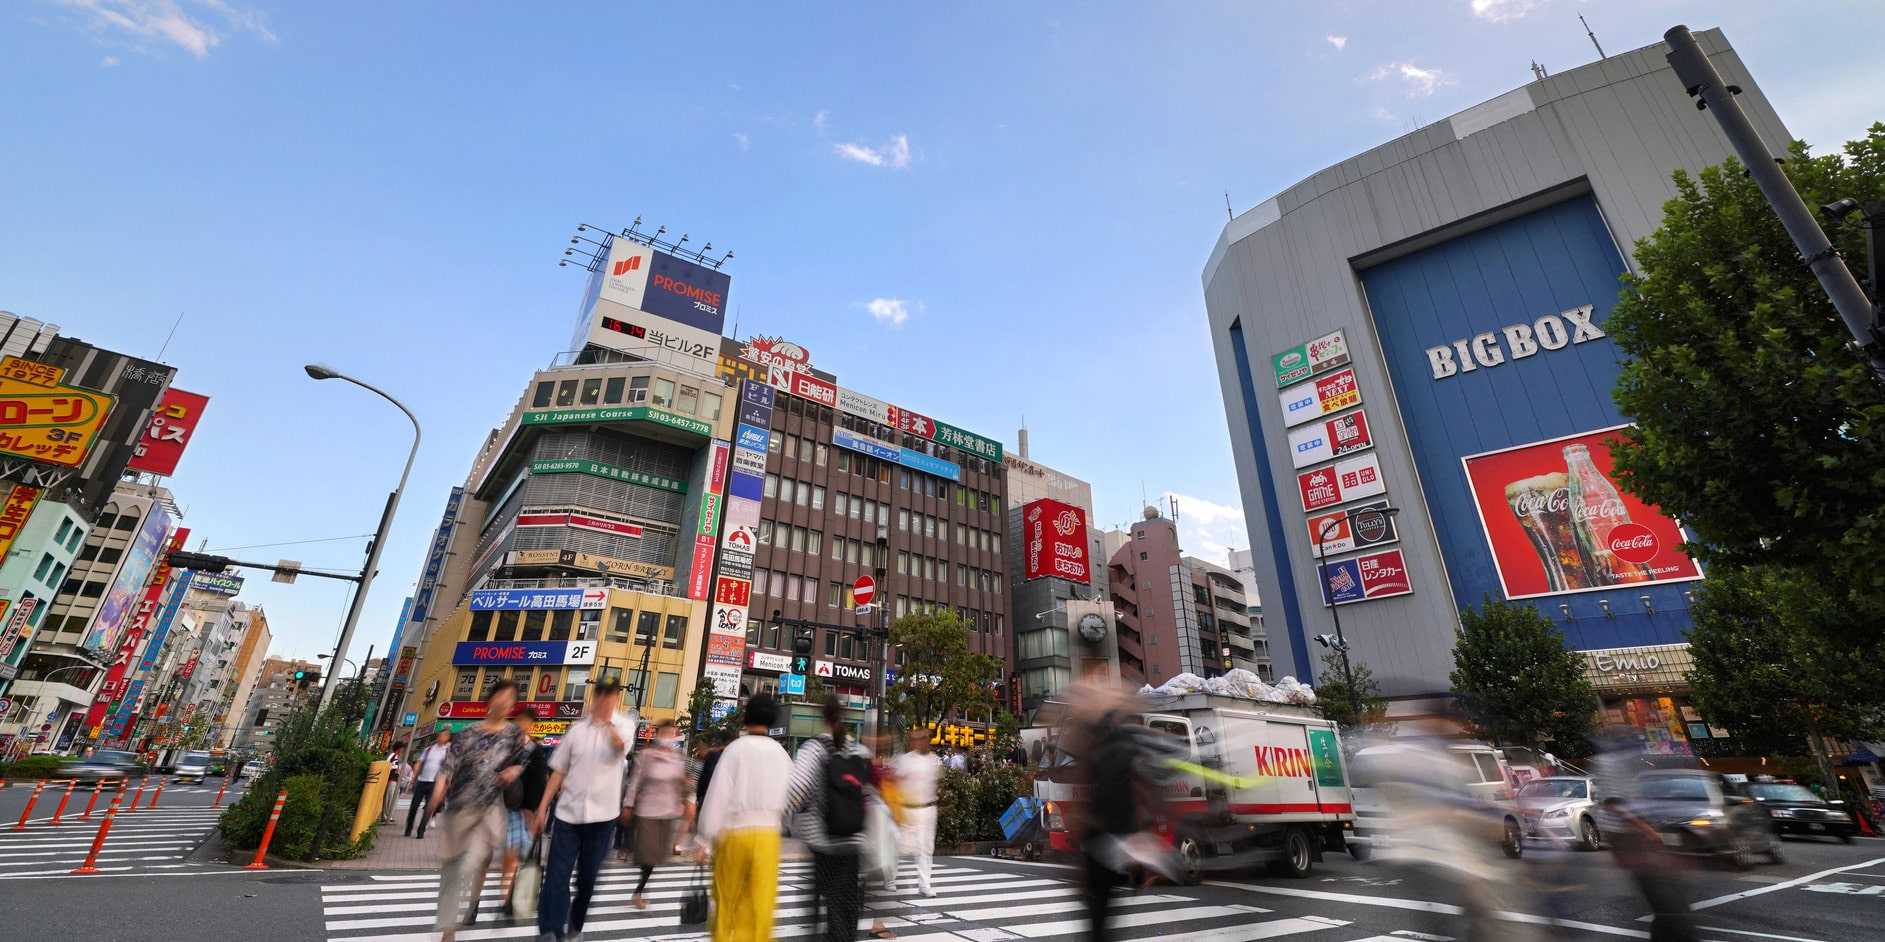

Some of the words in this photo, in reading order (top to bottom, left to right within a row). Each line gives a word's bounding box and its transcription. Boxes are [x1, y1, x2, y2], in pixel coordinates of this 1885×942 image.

[653, 274, 721, 307] PROMISE
[693, 301, 718, 315] プロミス
[648, 330, 714, 359] 当ビル2F
[1425, 331, 1505, 380] BIG
[1502, 304, 1606, 359] BOX
[4, 367, 55, 385] 1977
[9, 359, 57, 377] SINCE
[1280, 367, 1308, 382] サイゼリヤ
[798, 379, 835, 404] 日能研
[1325, 384, 1348, 399] NEXT
[840, 400, 867, 413] Menicon
[869, 409, 886, 420] Miru
[841, 393, 877, 409] コンタクトレンズ
[0, 399, 82, 425] ローン
[534, 411, 547, 422] SJI
[552, 411, 596, 421] Japanese
[600, 409, 633, 419] Course
[648, 410, 659, 420] SJI
[660, 414, 709, 433] 03-6457-3778
[911, 416, 928, 435] 本
[47, 428, 83, 444] 3F
[940, 426, 997, 458] 芳林堂書店
[746, 451, 765, 461] ヤマハ
[851, 440, 900, 460] 英会話イーオン
[542, 462, 580, 471] 03-6265-9570
[590, 463, 679, 491] 日本語教師養成講座
[1308, 483, 1335, 502] GAME
[1515, 487, 1569, 518] Coca-Co
[704, 496, 716, 533] サイゼリヤ
[728, 542, 751, 552] TOMAS
[1612, 535, 1652, 551] Coca-Cola
[153, 539, 182, 585] パンコ
[1055, 558, 1085, 577] まちおか
[1361, 559, 1379, 571] 日産
[1363, 568, 1402, 581] レンタカー
[1611, 571, 1634, 580] TASTE
[1649, 565, 1679, 576] FEELING
[473, 593, 581, 608] ベルサール高田馬場
[115, 601, 152, 665] エスパス
[473, 646, 526, 660] PROMISE
[528, 651, 547, 659] プロミス
[572, 647, 590, 659] 2F
[1596, 653, 1659, 671] Emio
[760, 660, 784, 668] Menicon
[835, 665, 871, 680] TOMAS
[97, 681, 117, 704] 日拓
[539, 673, 557, 694] 0円
[1254, 745, 1312, 778] KIRIN
